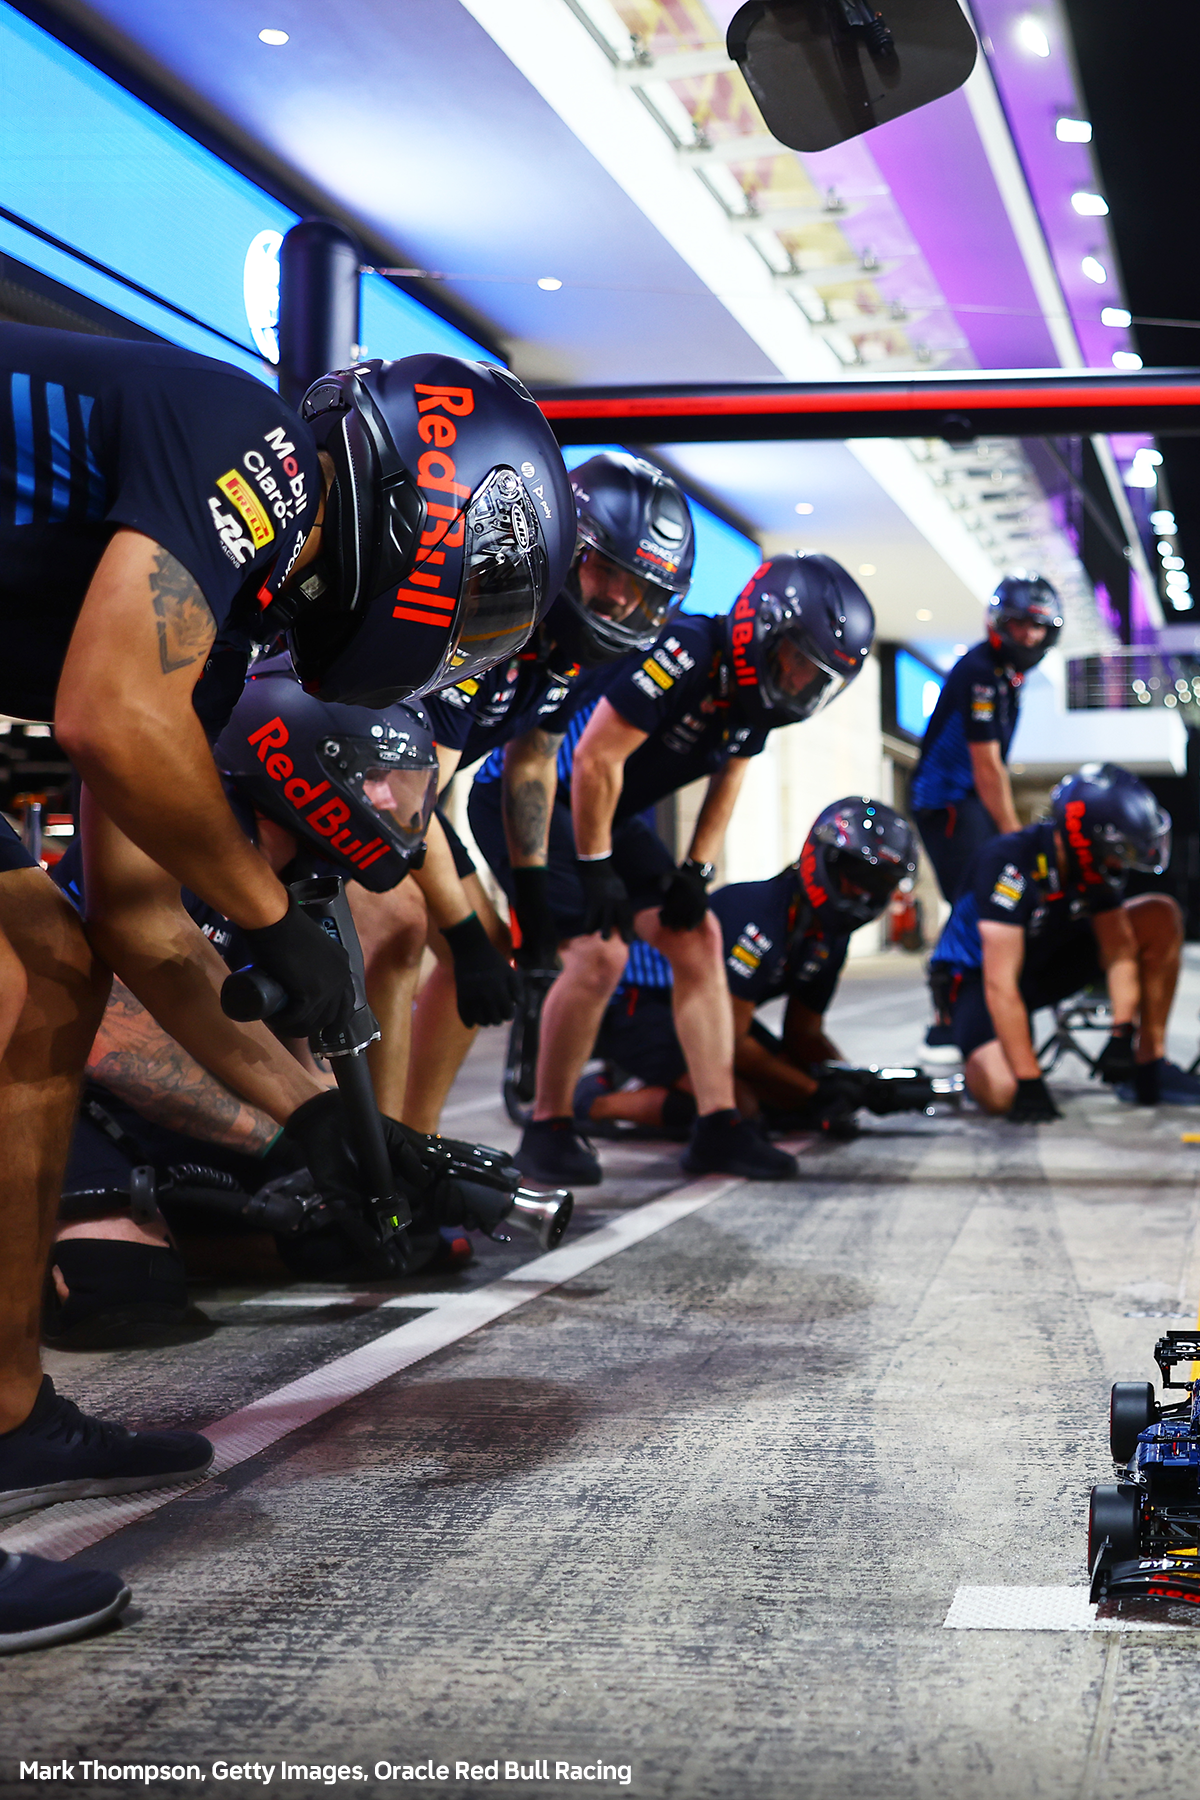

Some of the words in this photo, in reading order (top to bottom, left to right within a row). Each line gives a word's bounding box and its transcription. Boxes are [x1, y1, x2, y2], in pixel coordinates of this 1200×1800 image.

[243, 451, 290, 522] Claro
[264, 427, 307, 514] Mobil
[225, 477, 269, 541] PIRELLI
